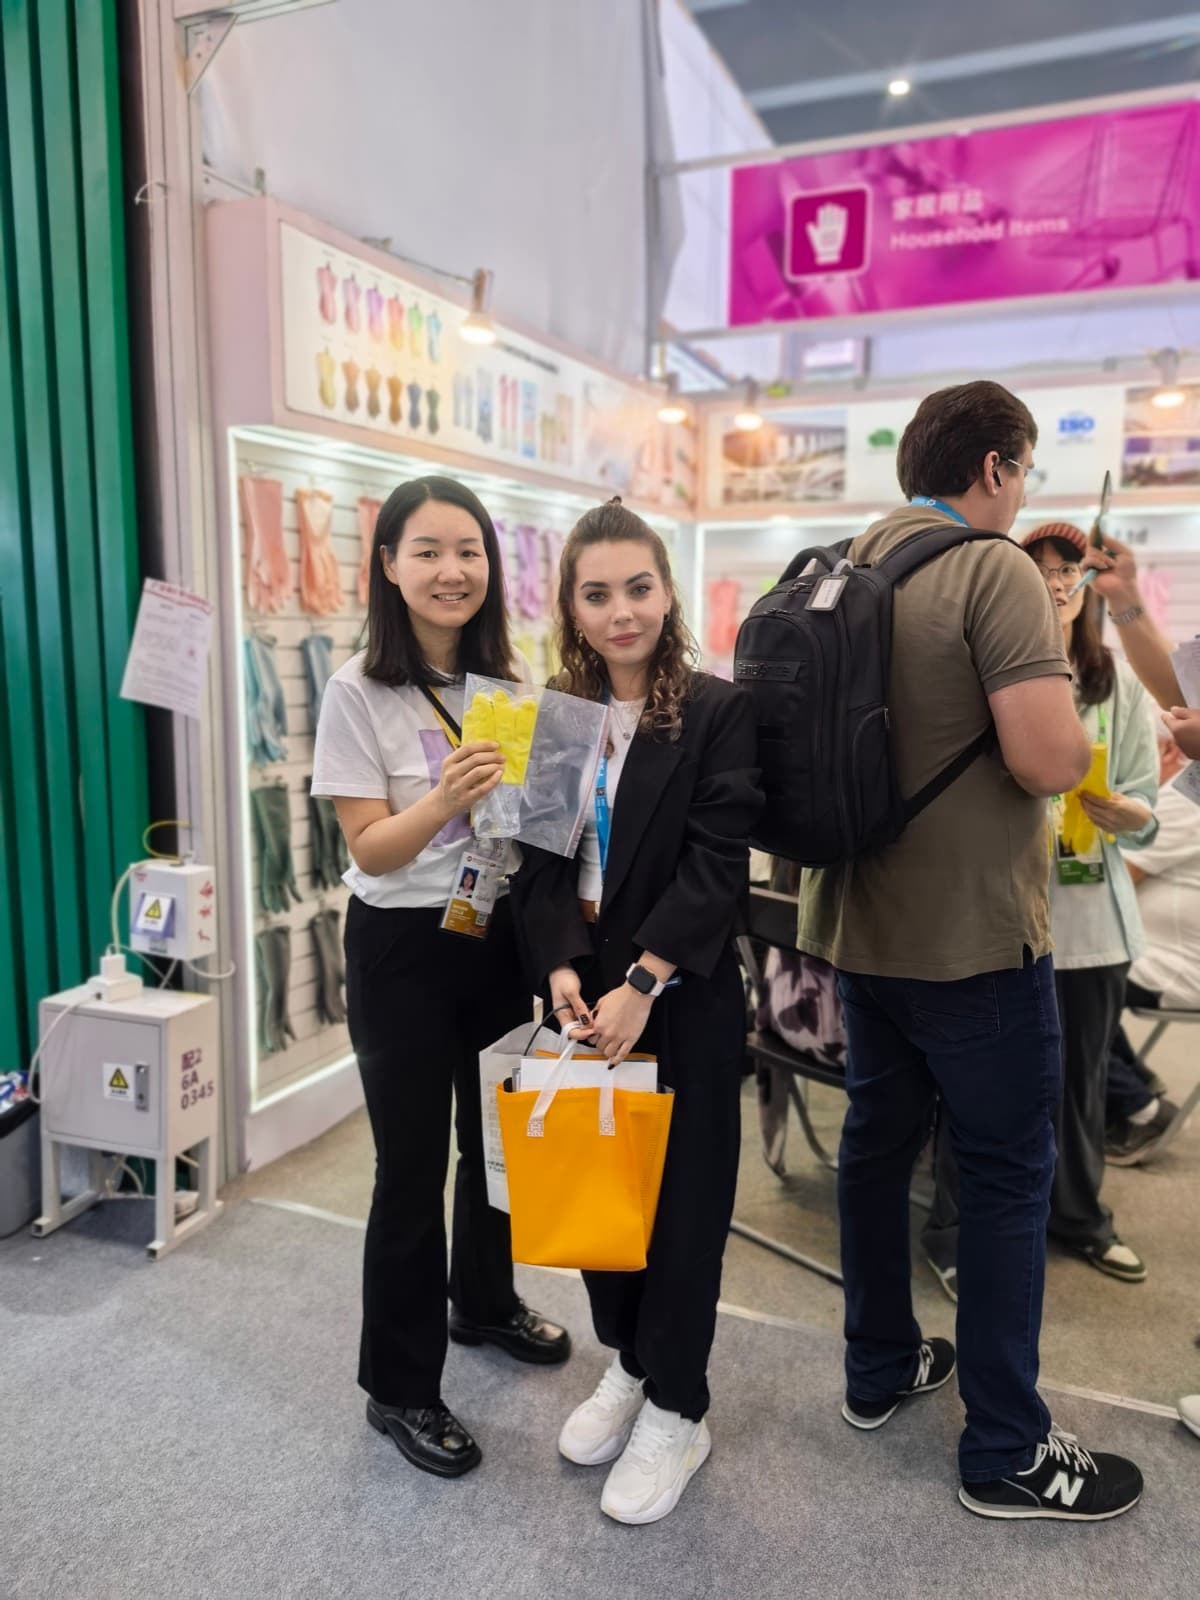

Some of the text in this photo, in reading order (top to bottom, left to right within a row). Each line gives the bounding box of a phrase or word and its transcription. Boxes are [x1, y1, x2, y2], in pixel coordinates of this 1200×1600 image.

[890, 216, 1069, 249] Household Items
[1059, 416, 1095, 433] ISO
[180, 1080, 215, 1111] 0345
[181, 1070, 199, 1091] 6A
[1042, 1469, 1085, 1507] N
